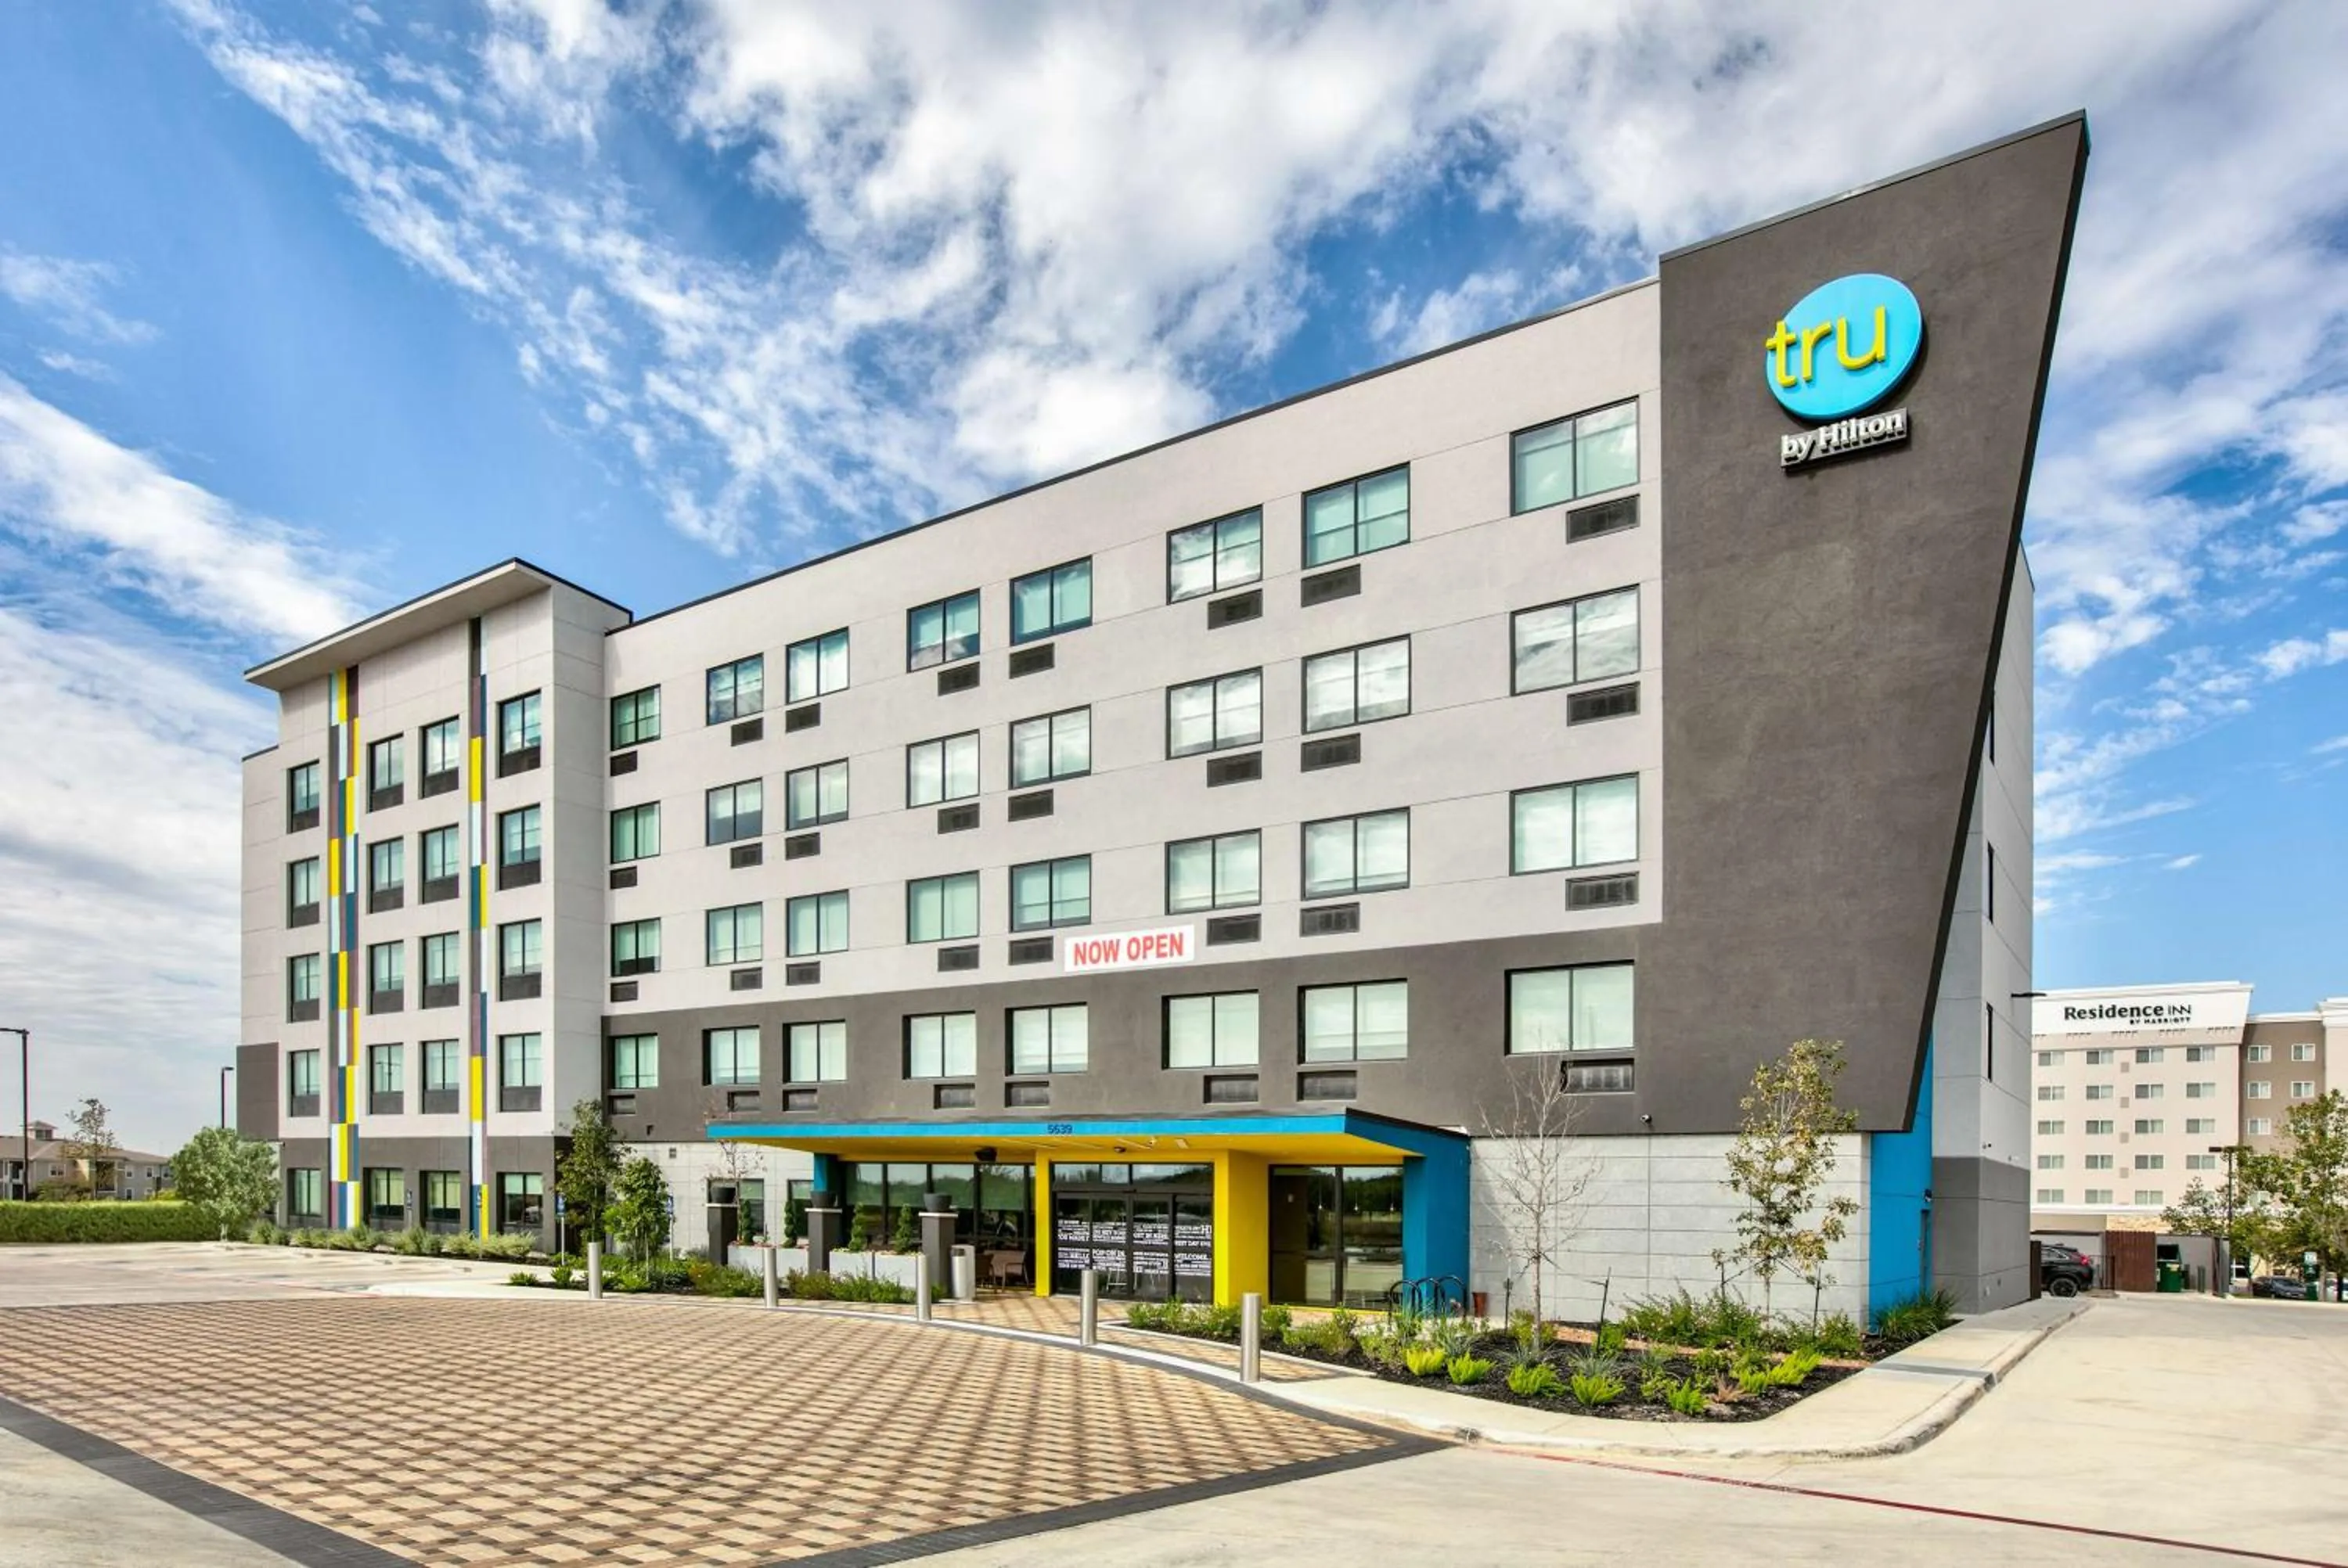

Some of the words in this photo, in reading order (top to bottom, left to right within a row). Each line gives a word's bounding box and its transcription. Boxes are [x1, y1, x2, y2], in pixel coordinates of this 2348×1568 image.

[1766, 304, 1885, 387] tru
[1781, 434, 1813, 459] by
[1819, 413, 1903, 448] Hilton
[1074, 938, 1120, 966] NOW
[1127, 932, 1184, 961] OPEN
[2064, 1004, 2164, 1021] Residence
[2167, 1004, 2191, 1016] INN
